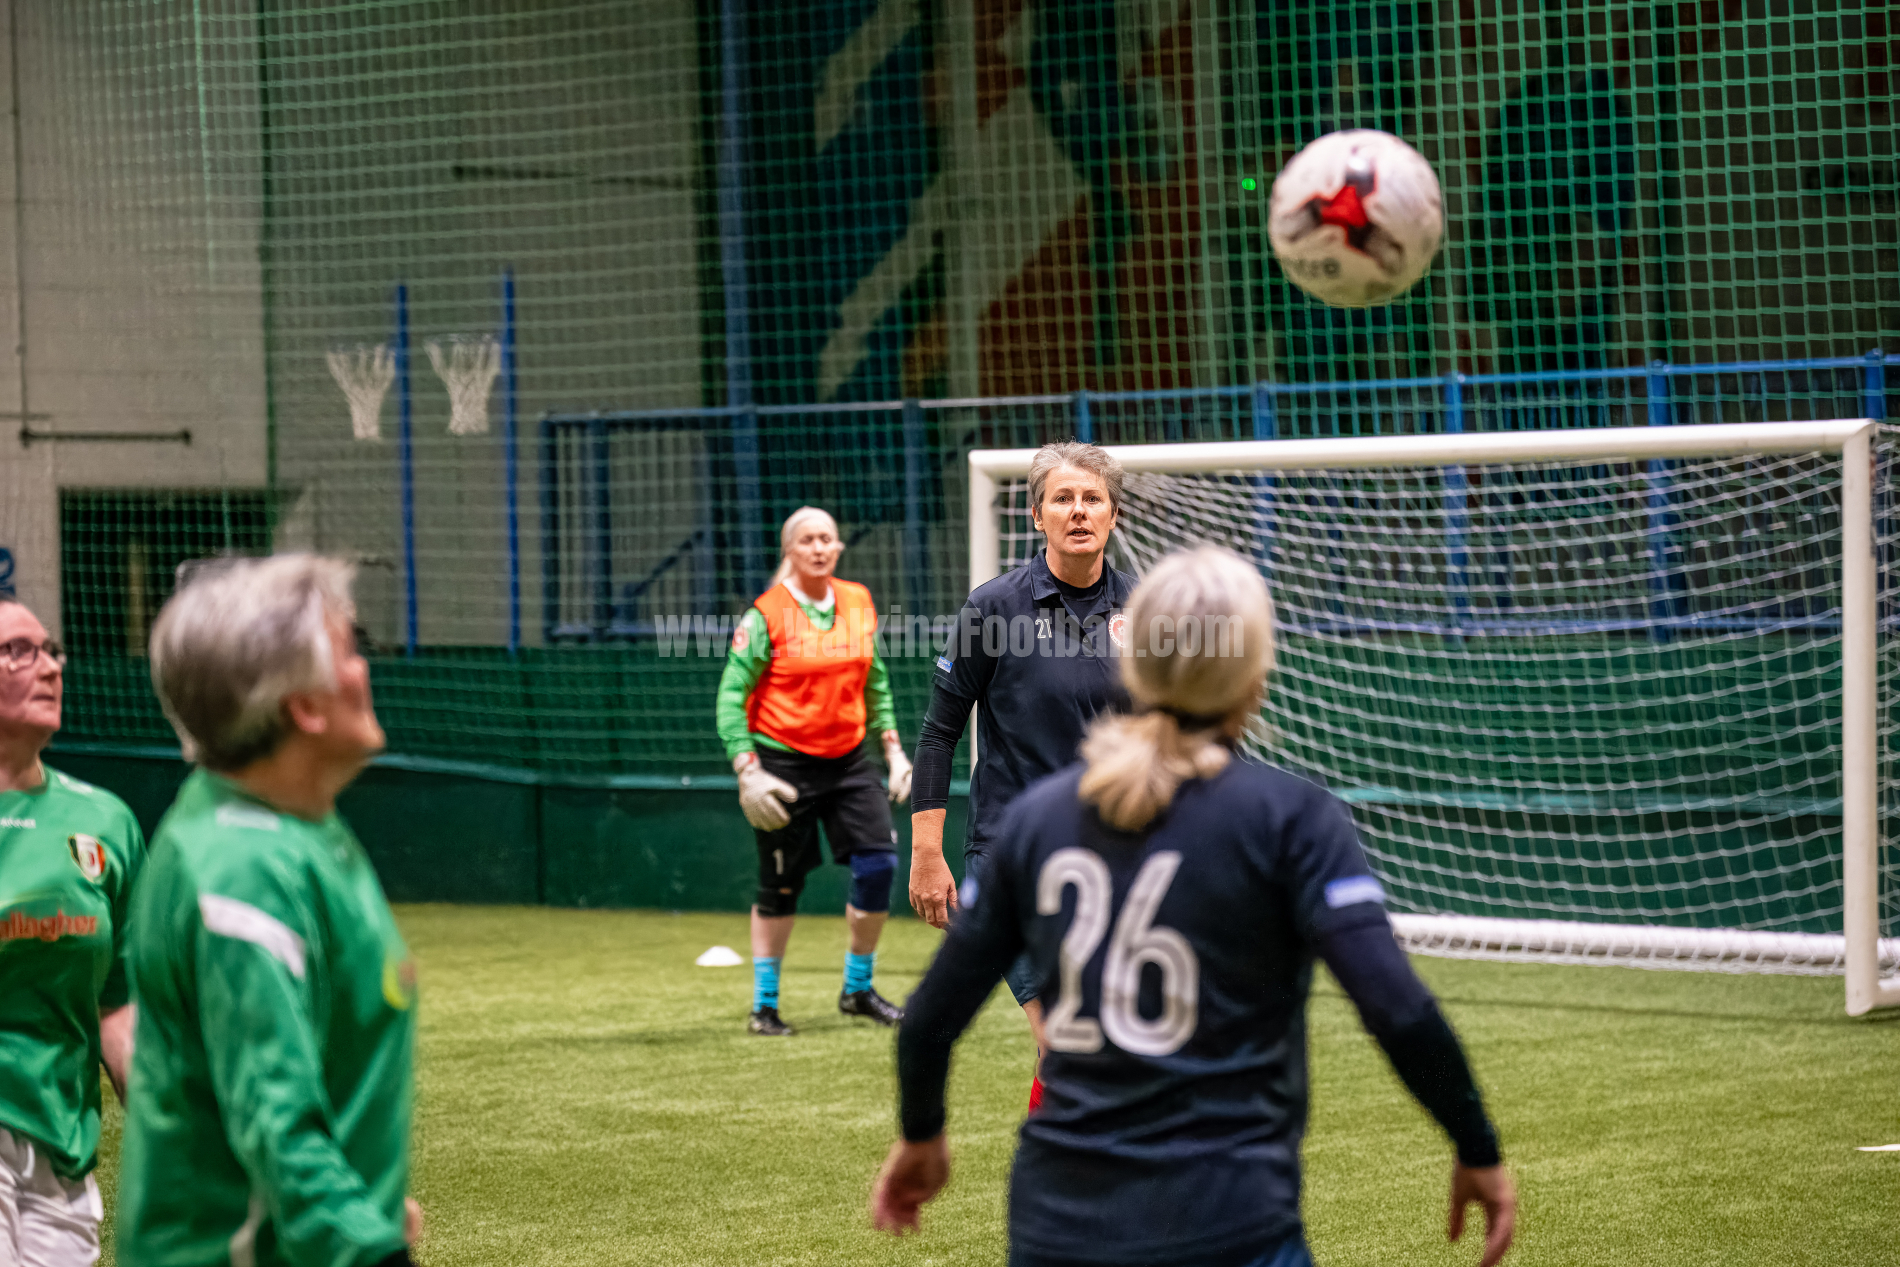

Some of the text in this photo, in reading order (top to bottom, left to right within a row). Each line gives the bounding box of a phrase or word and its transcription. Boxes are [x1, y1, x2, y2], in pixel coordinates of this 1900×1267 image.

[1034, 618, 1053, 639] 21
[773, 849, 785, 876] 1
[1036, 846, 1200, 1057] 26
